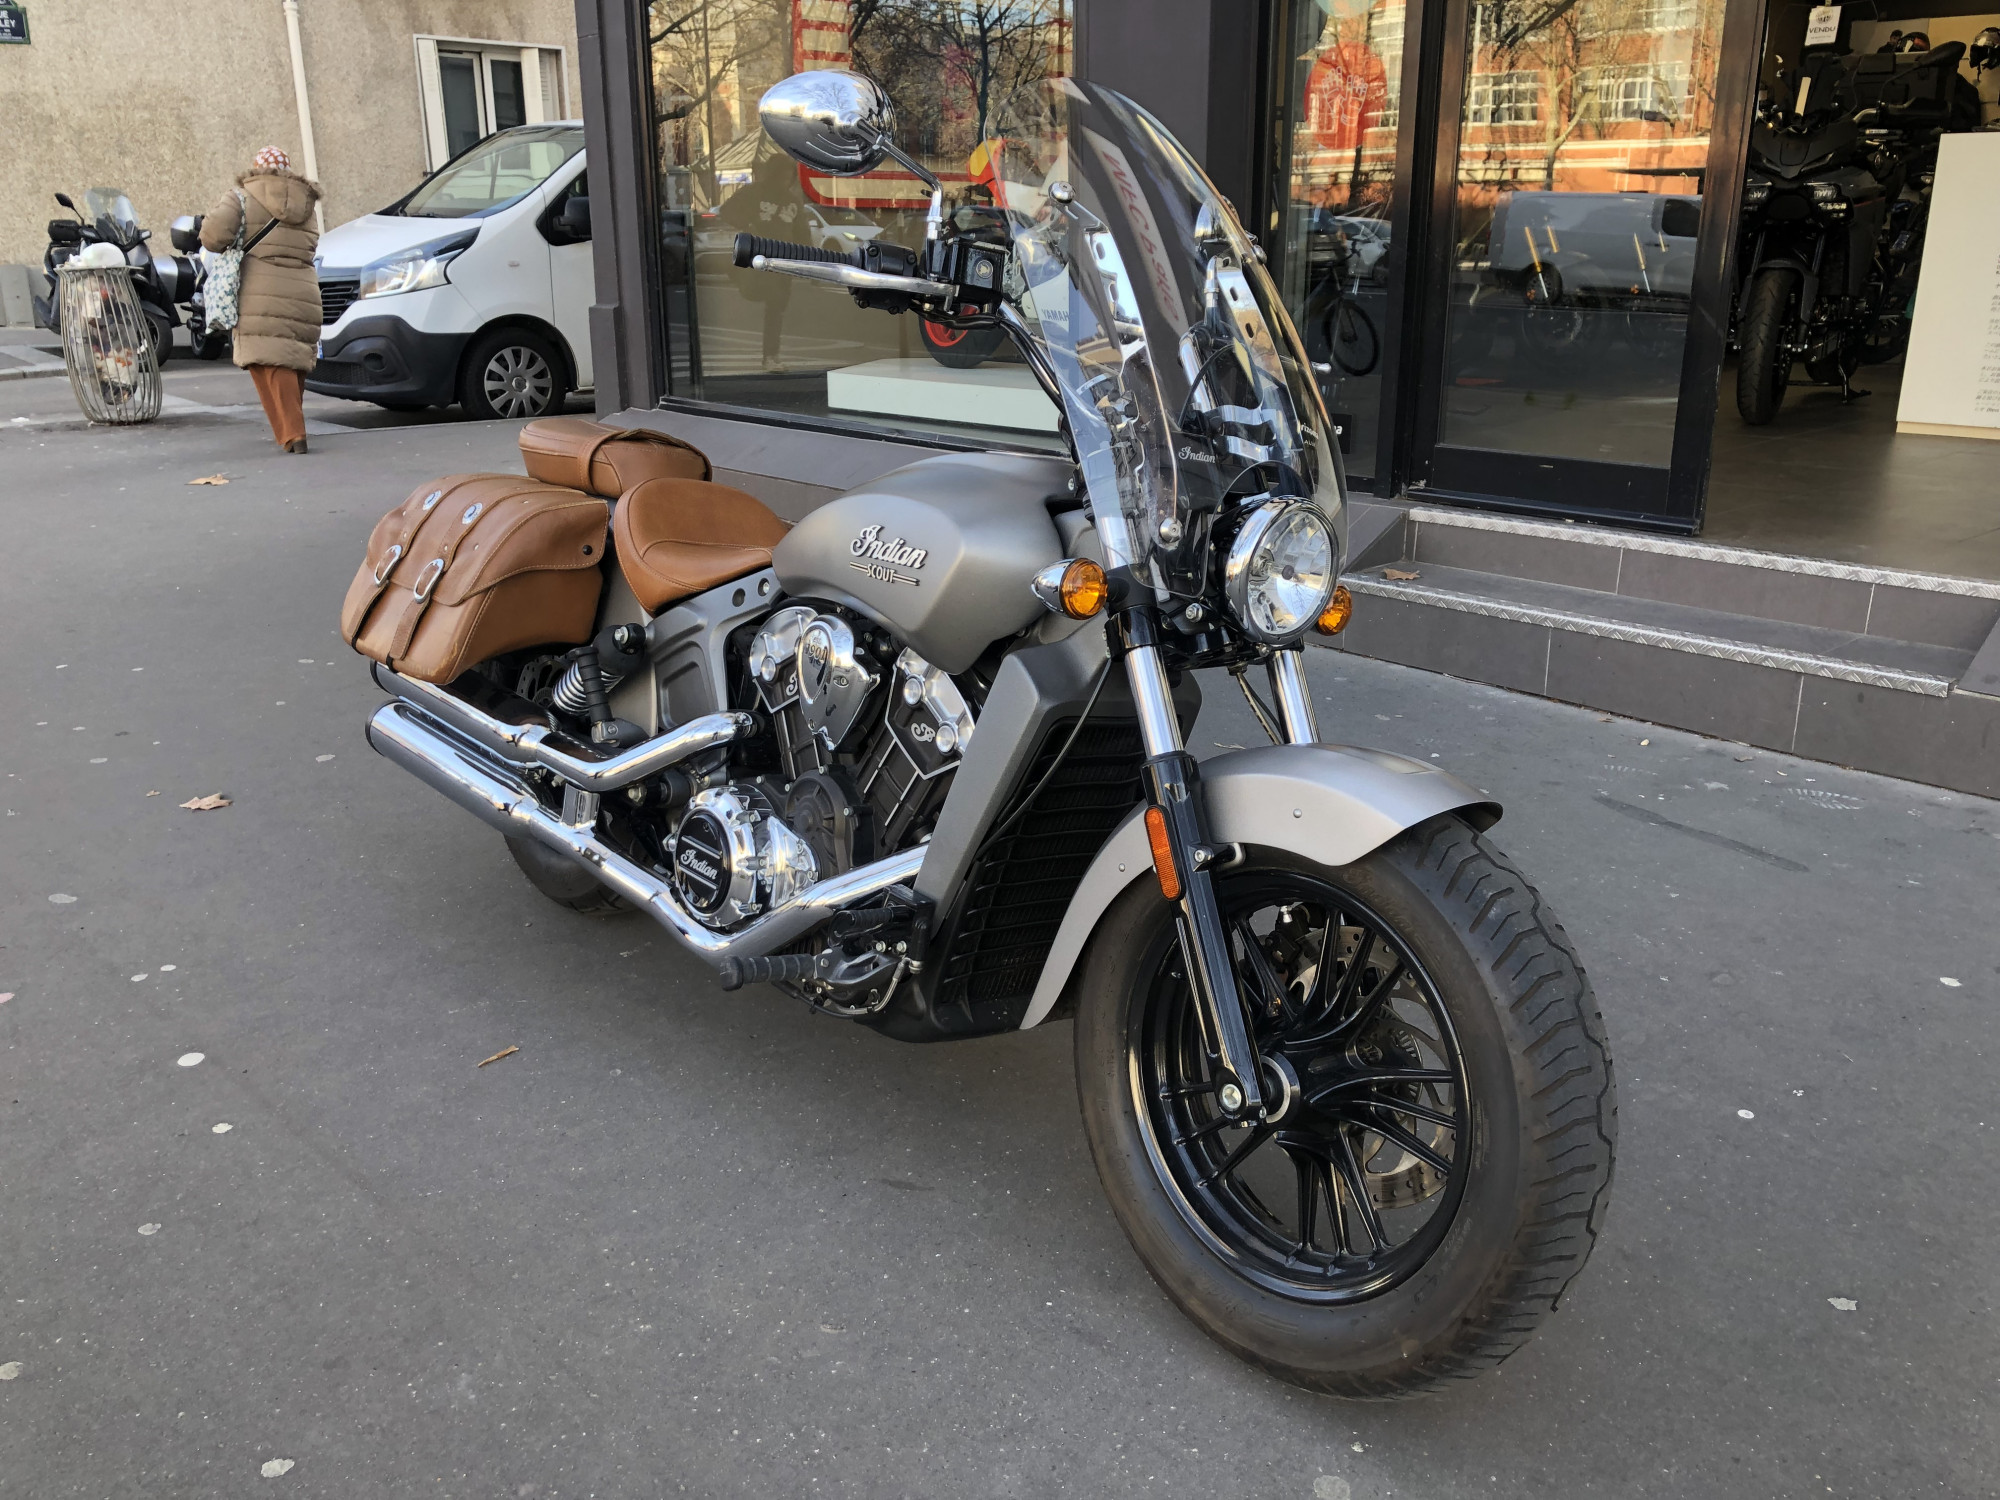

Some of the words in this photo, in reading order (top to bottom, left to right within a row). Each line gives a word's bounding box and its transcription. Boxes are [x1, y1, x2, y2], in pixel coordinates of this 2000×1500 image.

[1178, 445, 1216, 464] Indian
[850, 524, 928, 570] Indian
[866, 563, 896, 583] SCOUT
[680, 848, 719, 881] Indian
